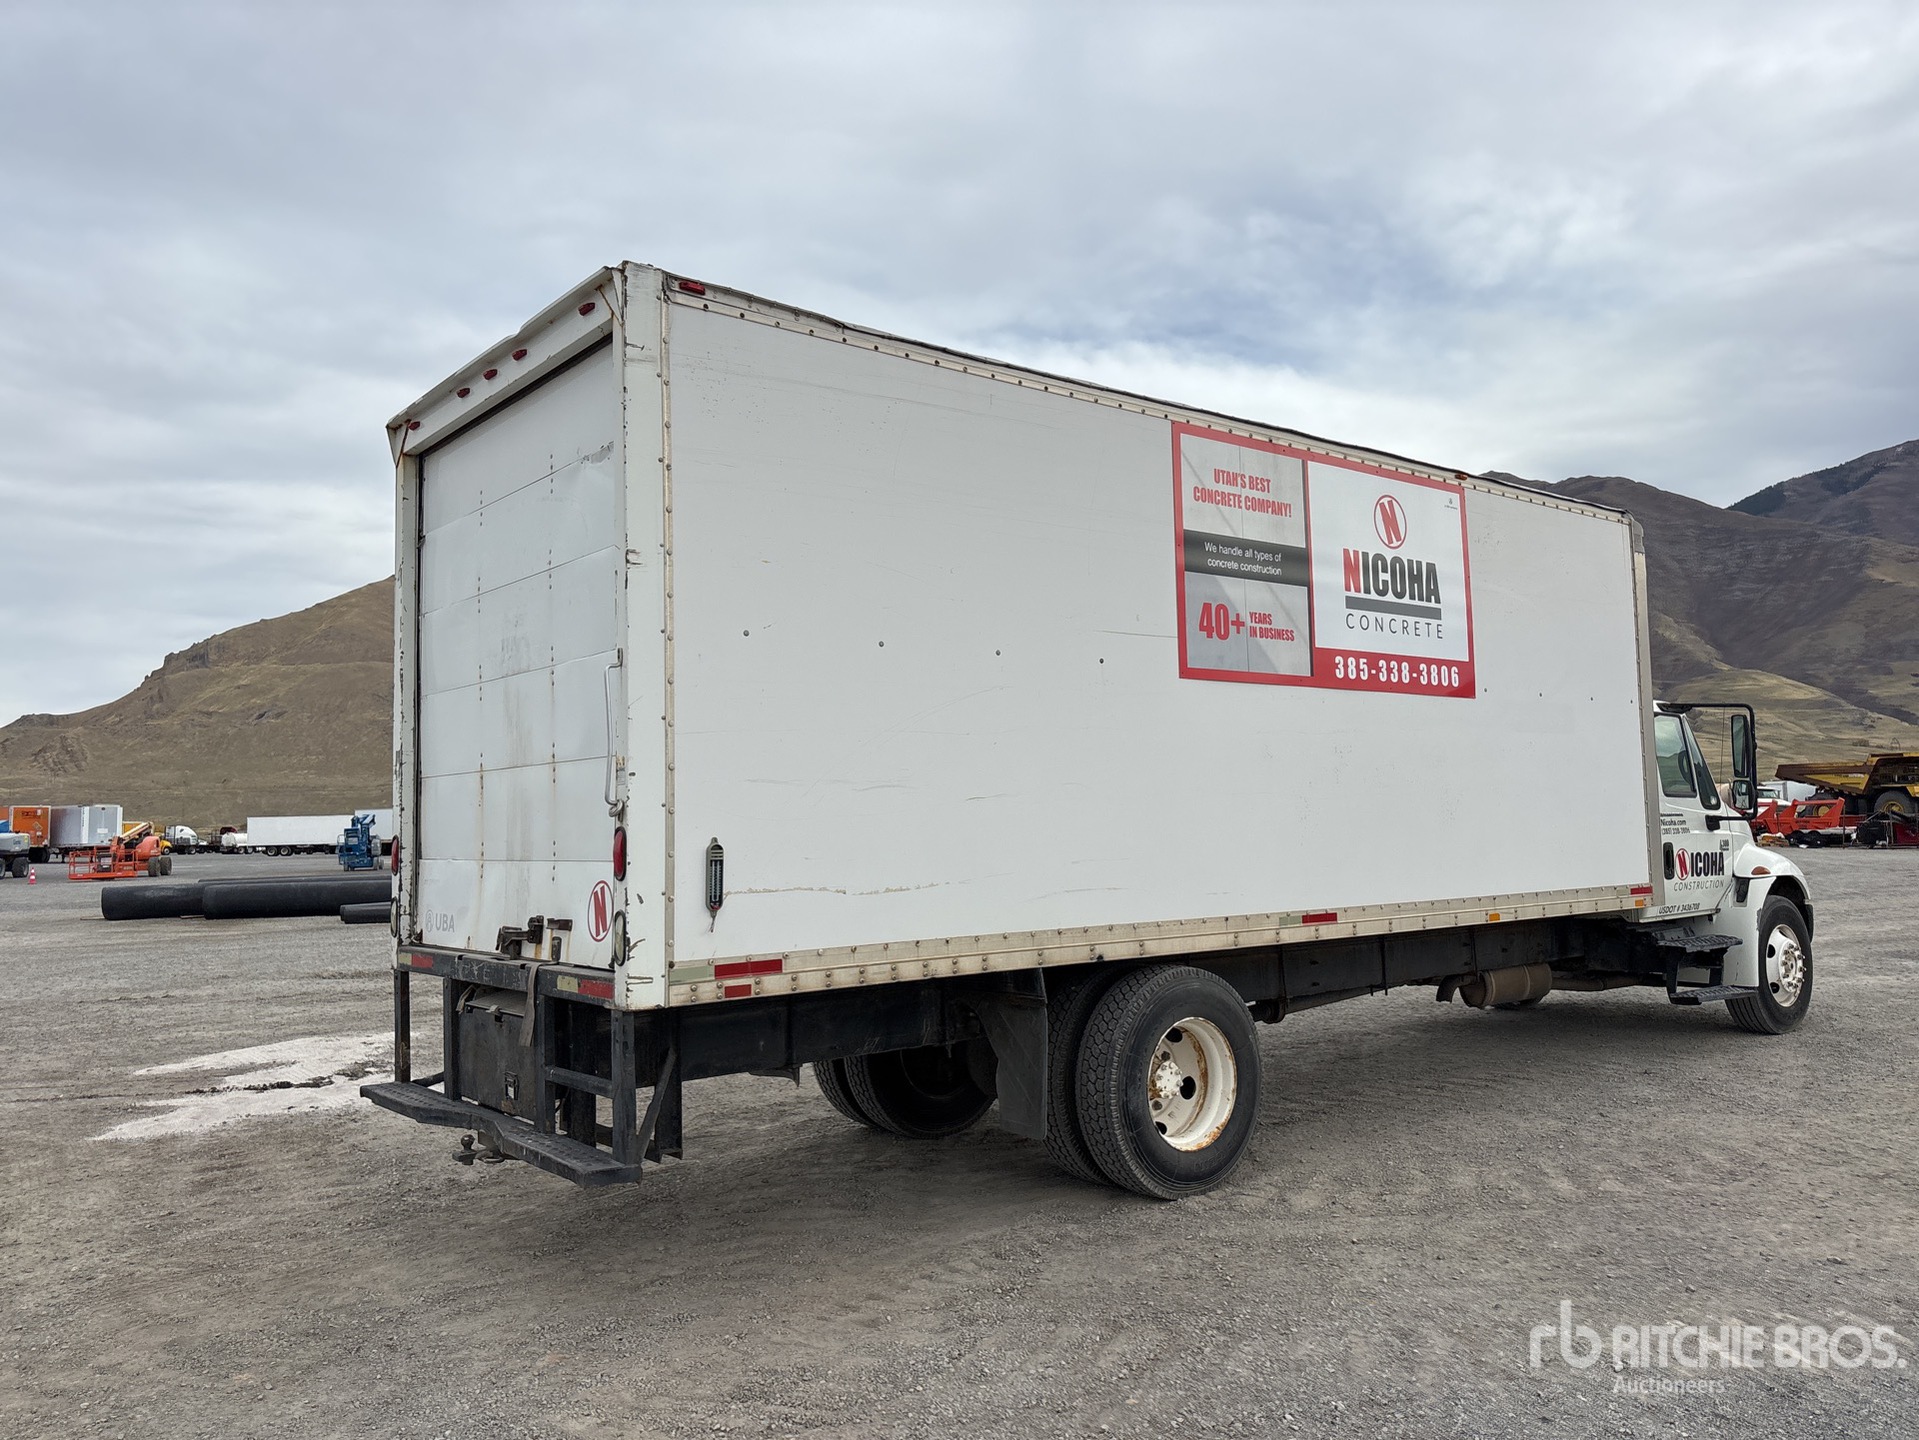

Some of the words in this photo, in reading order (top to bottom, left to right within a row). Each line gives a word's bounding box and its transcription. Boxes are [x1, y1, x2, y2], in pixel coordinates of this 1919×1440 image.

[1213, 468, 1247, 489] UTAH'S
[1248, 475, 1271, 493] BEST
[1193, 486, 1243, 509] CONCRETE
[1244, 495, 1292, 518] COMPANY!
[1204, 541, 1217, 553] We
[1219, 544, 1243, 557] handle
[1244, 547, 1253, 558] all
[1254, 550, 1274, 562] types
[1274, 552, 1282, 562] of
[1207, 557, 1239, 570] concrete
[1240, 561, 1282, 576] construction
[1342, 547, 1442, 604] NICOHA
[1198, 602, 1246, 641] 40+
[1249, 611, 1273, 626] YEARS
[1345, 612, 1444, 640] CONCRETE
[1249, 625, 1258, 639] IN
[1259, 626, 1295, 642] BUSINESS
[1334, 655, 1460, 688] 385-338-3806
[1660, 818, 1687, 827] Nicoha.com
[1676, 850, 1725, 879] NICOHA
[1673, 880, 1724, 892] CONSTRUCTION
[1658, 904, 1677, 914] USDOT
[435, 912, 455, 933] UBA
